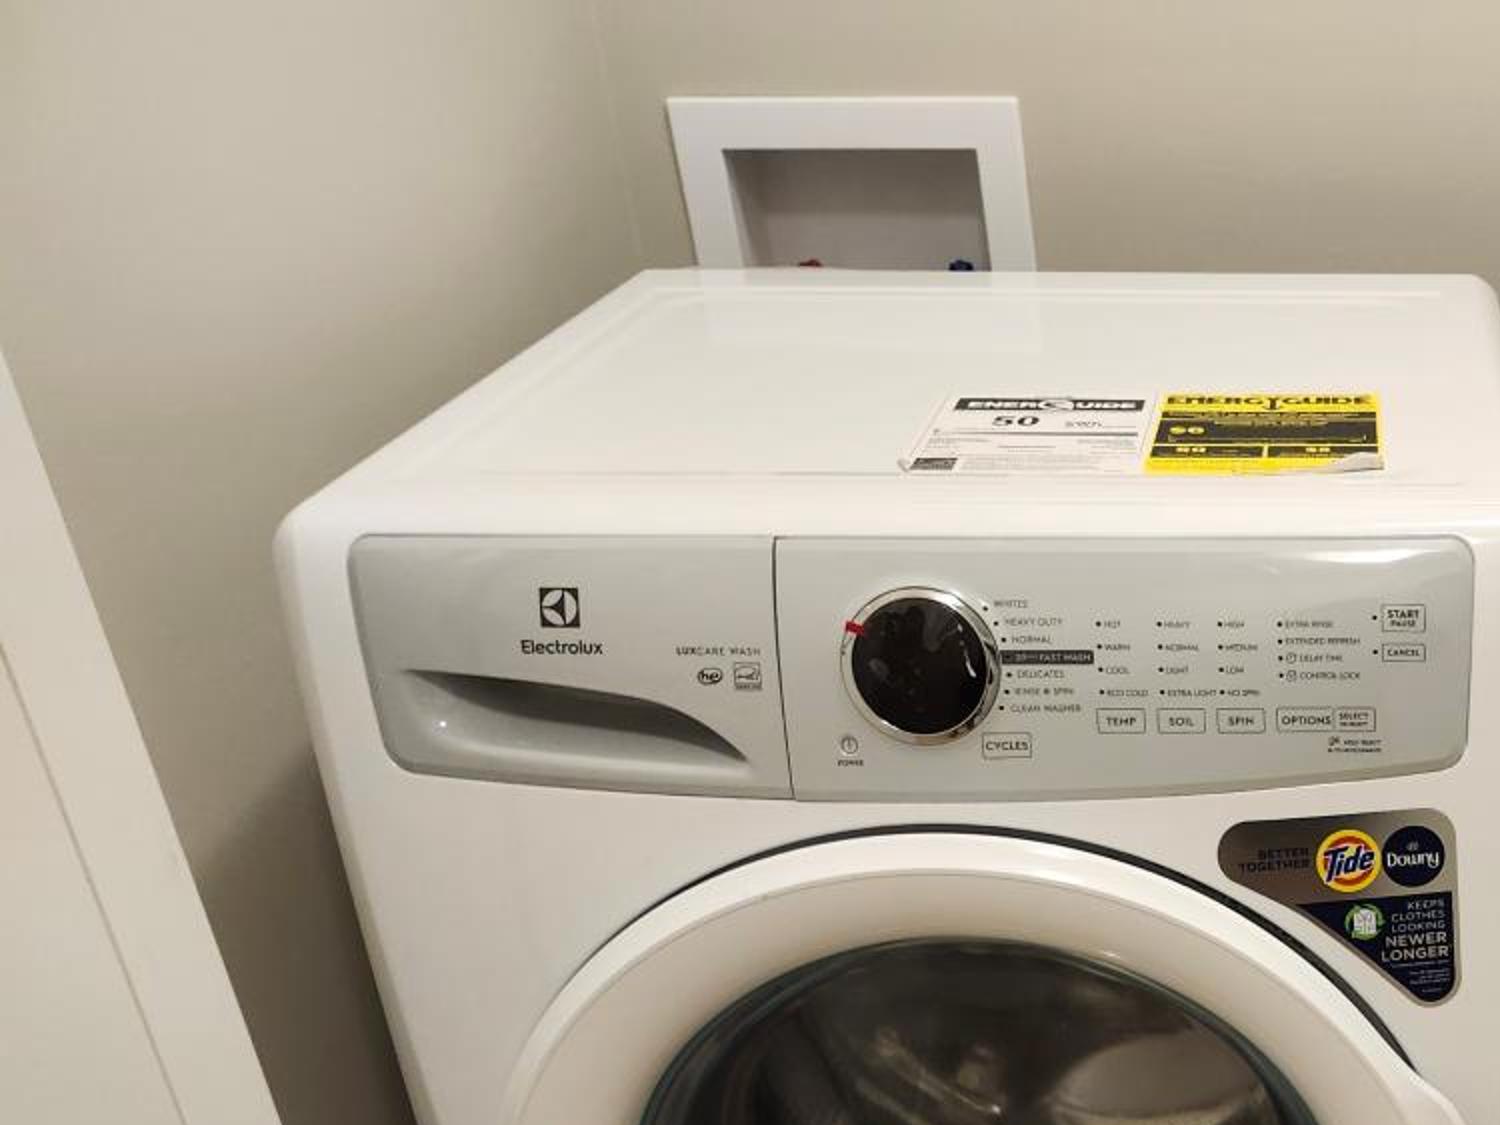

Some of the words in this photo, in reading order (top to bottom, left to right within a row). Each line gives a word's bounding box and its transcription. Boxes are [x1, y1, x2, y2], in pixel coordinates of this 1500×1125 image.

[992, 415, 1041, 428] 50
[1387, 609, 1420, 619] START
[1005, 618, 1036, 627] HEAVY
[1038, 617, 1063, 626] DUTY
[1389, 619, 1416, 628] PAUSE
[1011, 636, 1052, 644] NORMAL
[520, 639, 604, 656] Electrolux
[1387, 649, 1420, 657] CANCEL
[1017, 670, 1064, 678] DELICATES
[1010, 703, 1040, 712] CLEAN
[1106, 717, 1137, 726] TEMP
[1169, 717, 1195, 726] SOIL
[1228, 716, 1255, 726] SPIN
[1281, 715, 1332, 726] OPTIONS
[985, 741, 1029, 751] CYCLES
[1258, 847, 1310, 860] BETTER
[1238, 858, 1311, 874] TOGETHER
[1323, 846, 1375, 883] Tide
[1387, 853, 1440, 869] Downy
[1407, 899, 1445, 910] KEEPS
[1392, 910, 1446, 923] CLOTHES
[1392, 920, 1446, 933] LOOKING
[1385, 931, 1447, 948] NEWER
[1381, 945, 1449, 962] LONGER
